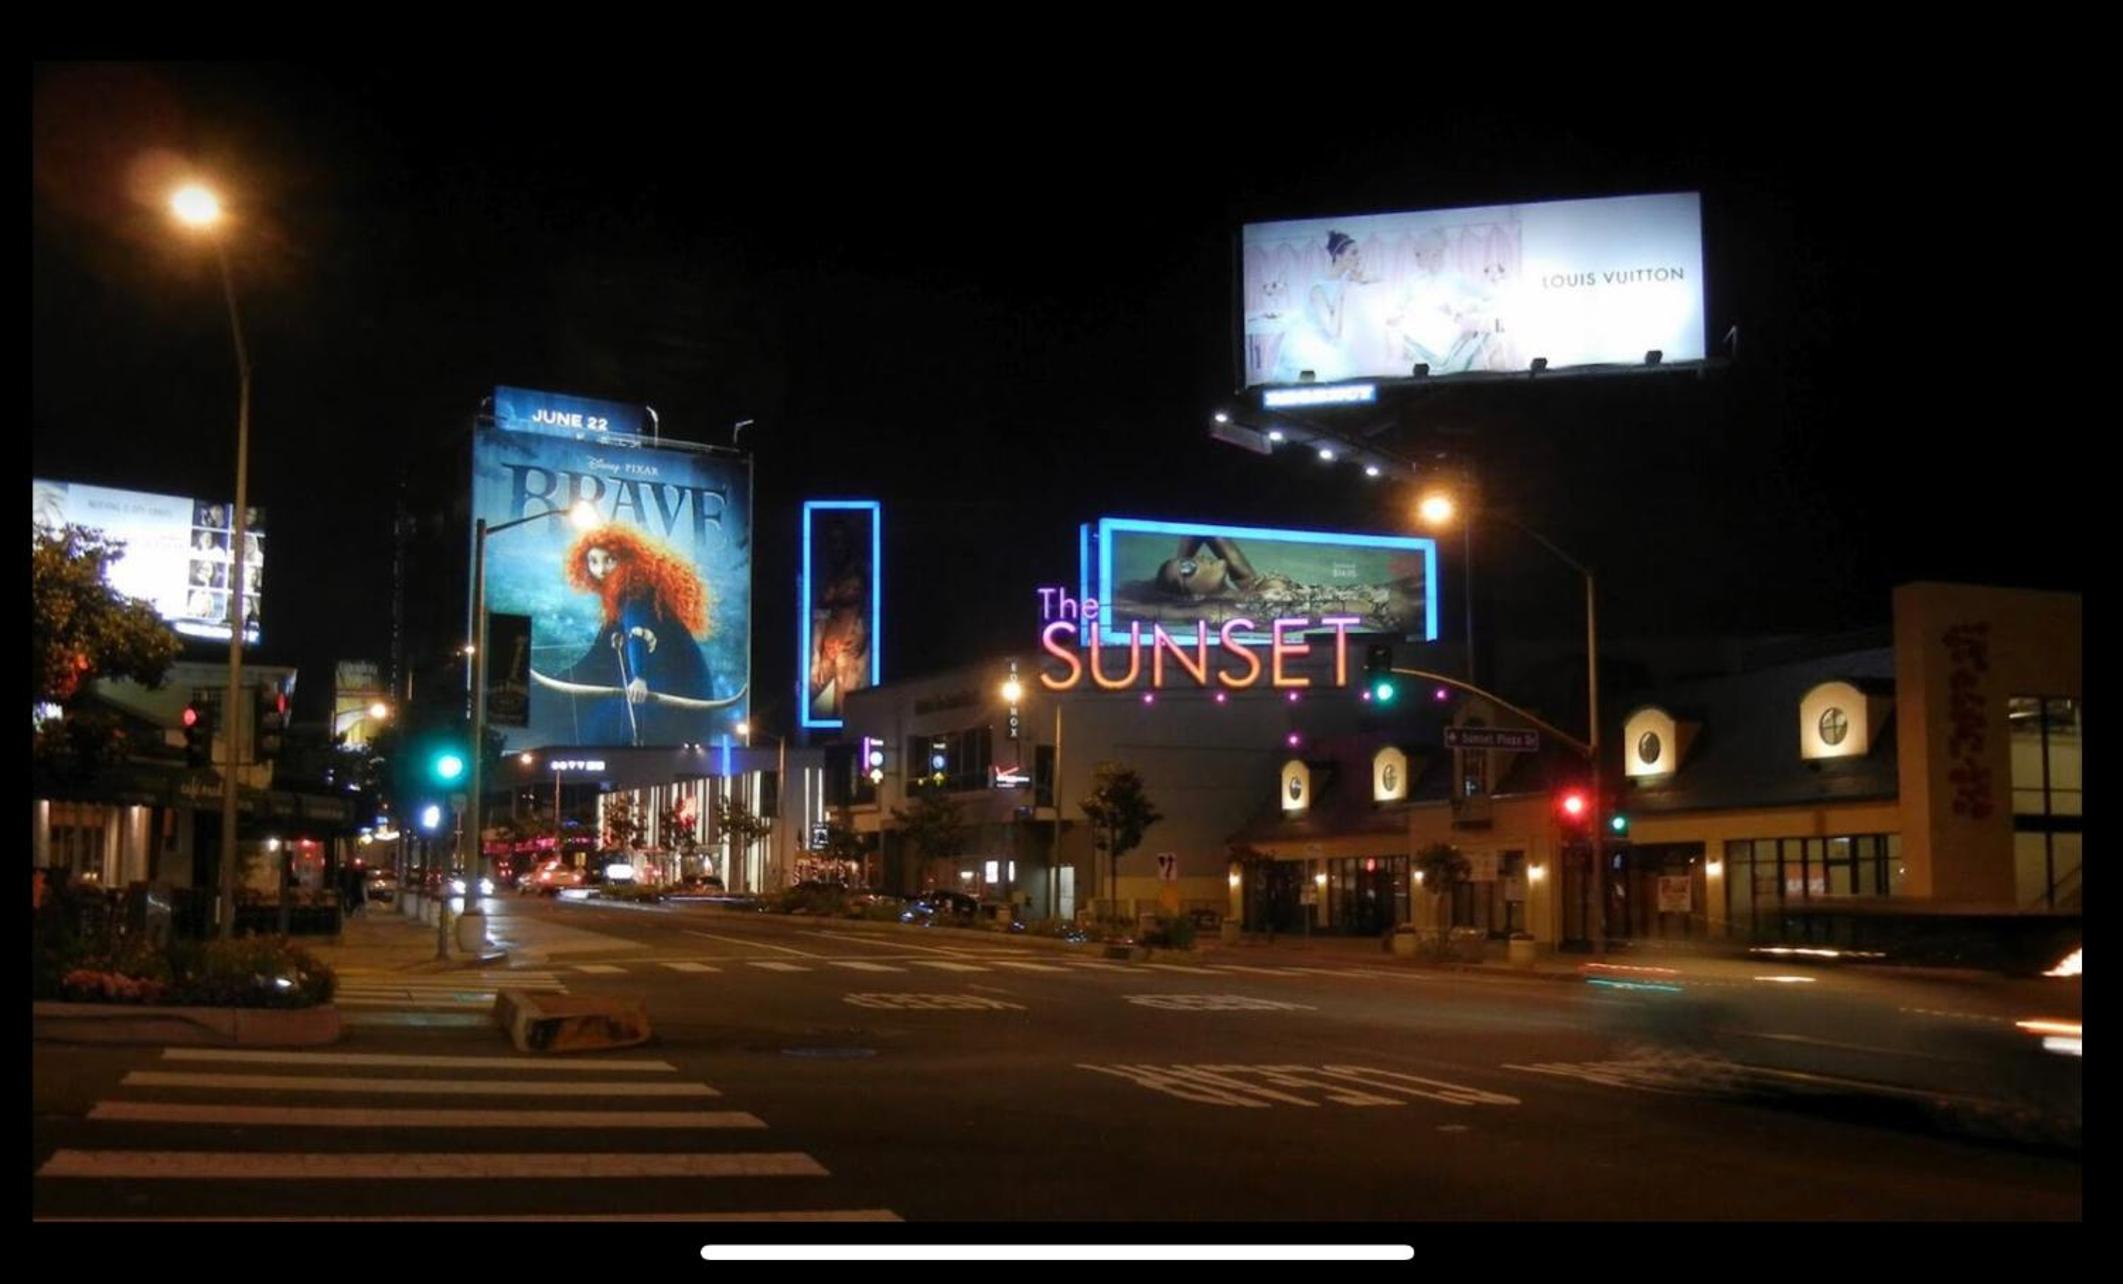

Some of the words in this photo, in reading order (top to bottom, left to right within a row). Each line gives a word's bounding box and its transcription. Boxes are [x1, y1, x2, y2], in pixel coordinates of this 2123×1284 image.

[1542, 271, 1596, 289] LOUIS
[1603, 266, 1684, 285] VUITTON
[531, 408, 583, 428] JUNE
[587, 416, 609, 433] 22
[586, 455, 621, 474] Disney
[625, 463, 659, 476] PIXAR
[501, 461, 729, 546] BRAVE
[1037, 587, 1099, 620] The
[1040, 617, 1361, 690] SUNSET
[1462, 731, 1494, 745] Sunset
